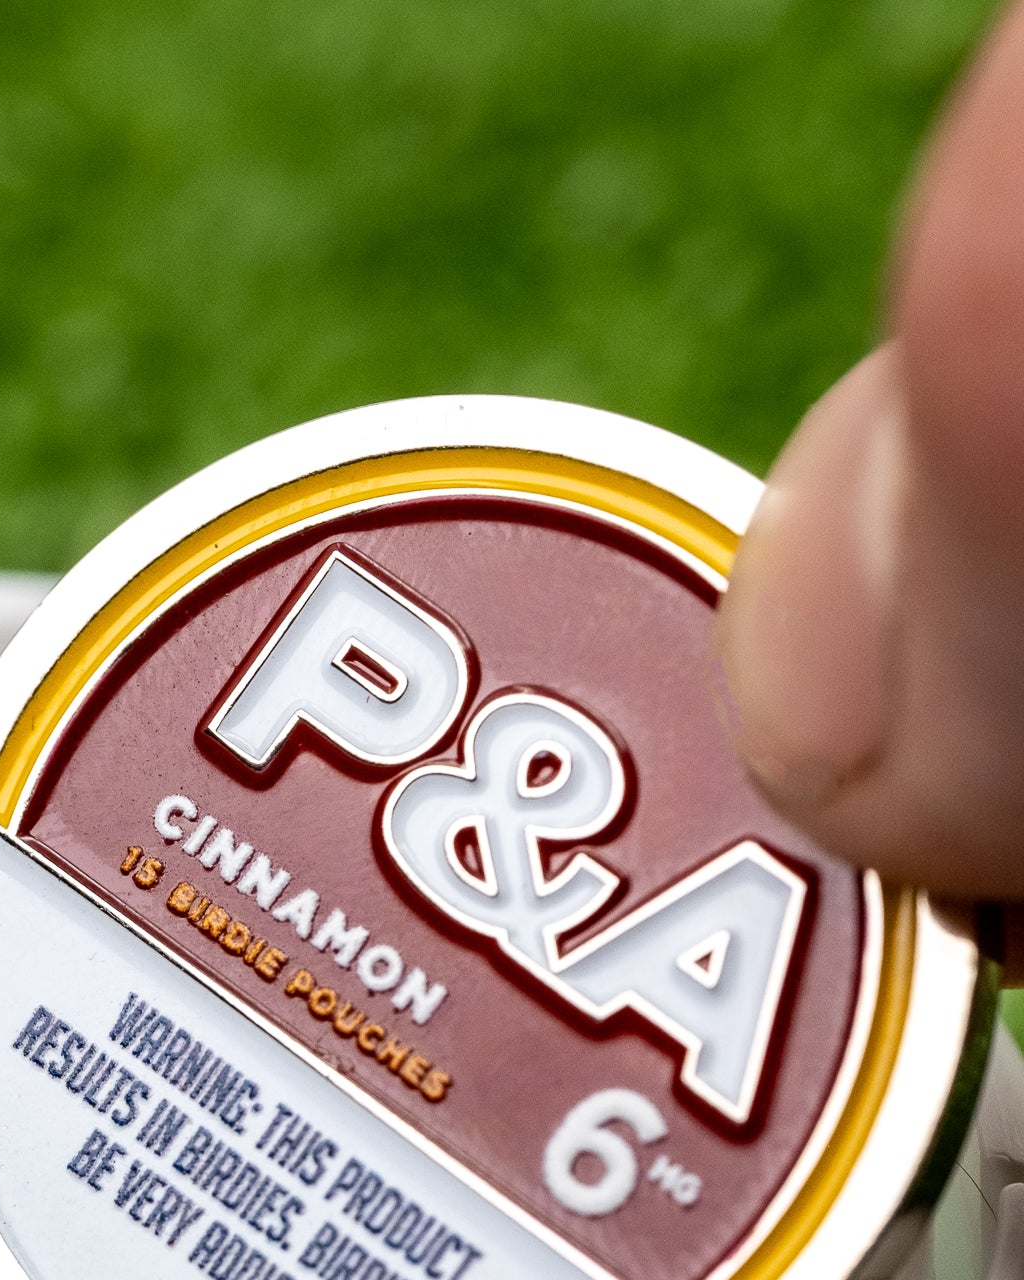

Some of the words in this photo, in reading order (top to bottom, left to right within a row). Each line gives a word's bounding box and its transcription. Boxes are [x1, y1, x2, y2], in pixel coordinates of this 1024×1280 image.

[153, 794, 448, 1025] CINNAMON
[207, 549, 810, 1126] P&A
[120, 845, 165, 889] 15
[166, 881, 288, 982] BIRDIE
[285, 968, 453, 1101] POUCHES
[12, 1005, 152, 1127] RESULTS
[135, 1098, 189, 1157] IN
[172, 1125, 305, 1251] BIRDIES.
[67, 1128, 127, 1192] BE
[114, 1159, 205, 1246] VERY
[109, 991, 263, 1135] WARNING:
[255, 1101, 339, 1187] THIS
[543, 1087, 669, 1217] 6
